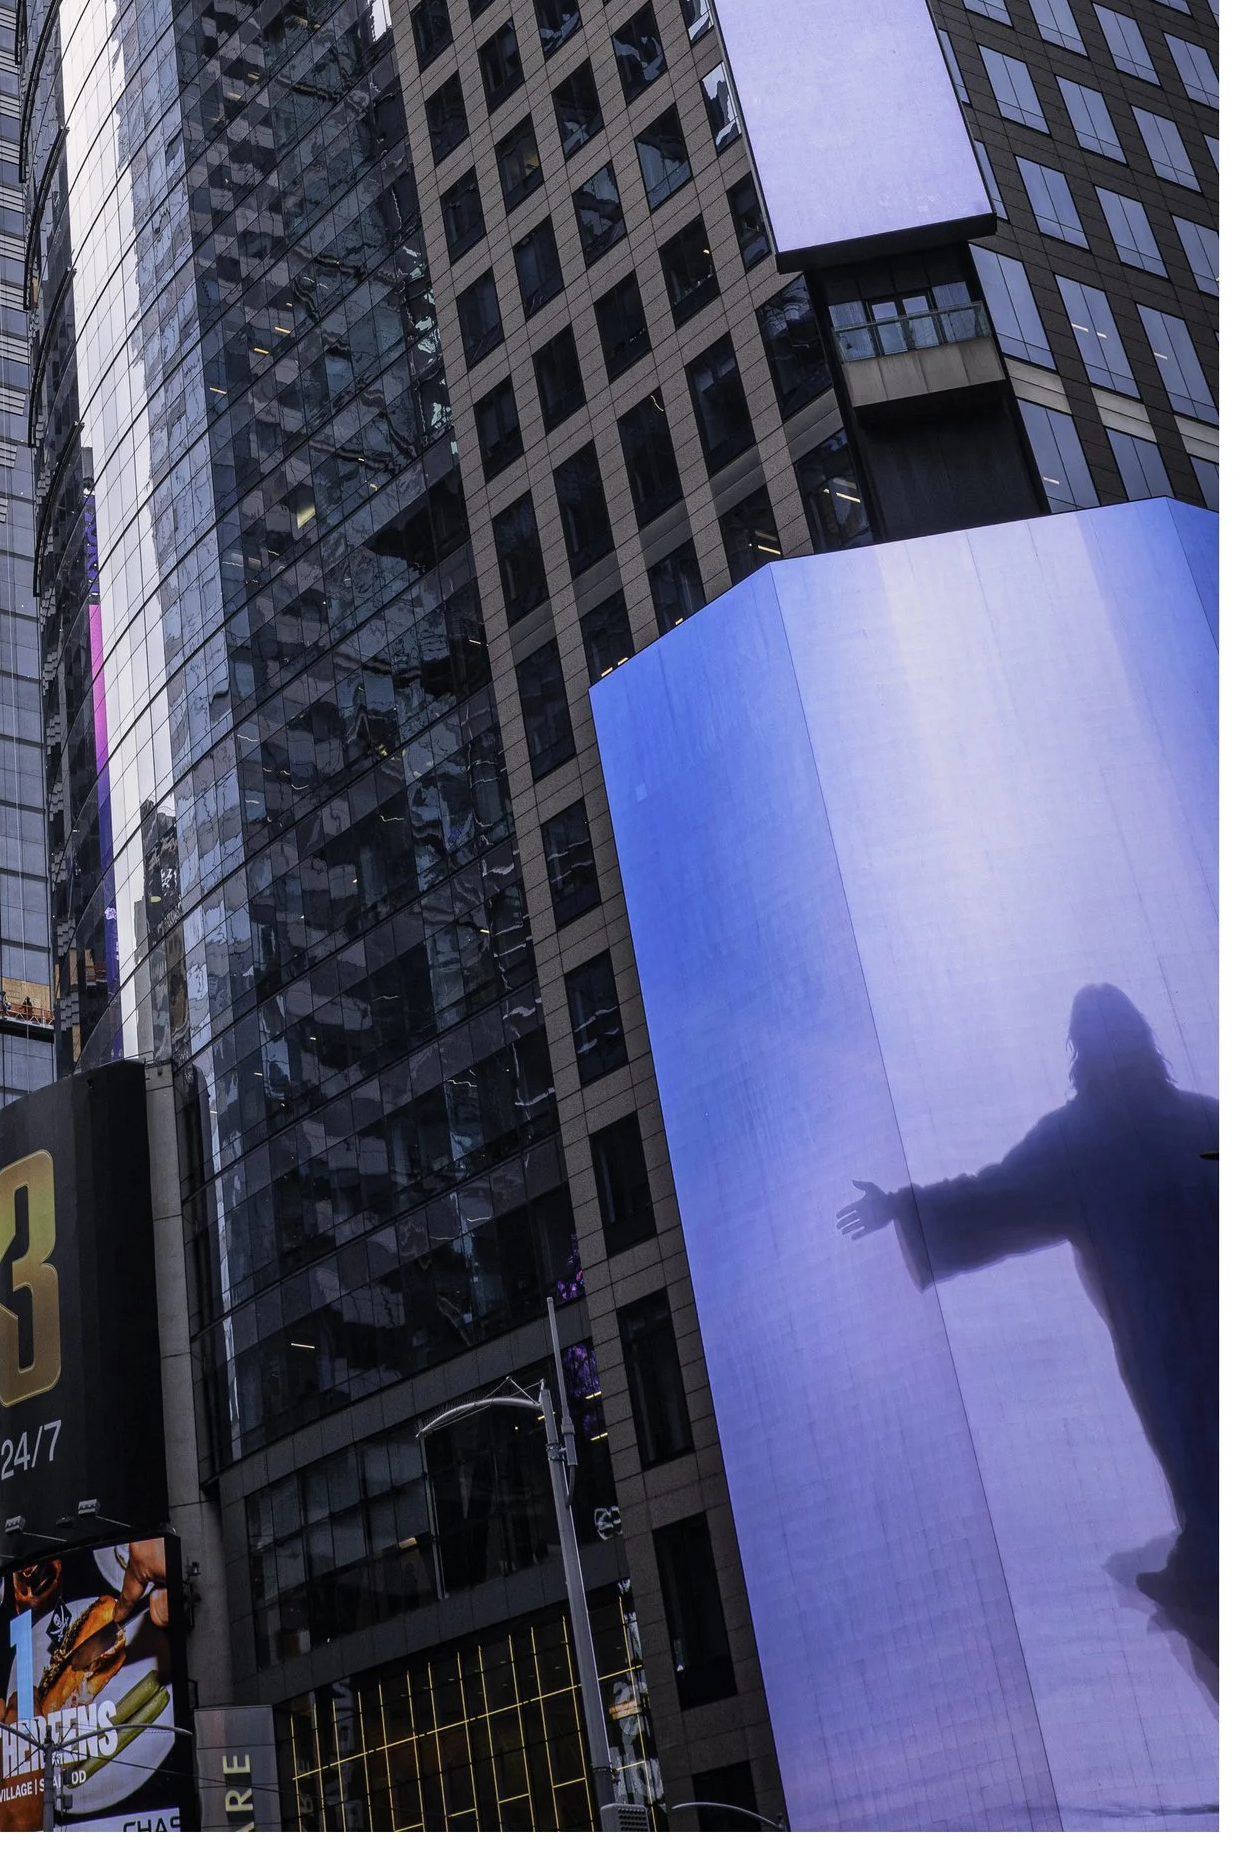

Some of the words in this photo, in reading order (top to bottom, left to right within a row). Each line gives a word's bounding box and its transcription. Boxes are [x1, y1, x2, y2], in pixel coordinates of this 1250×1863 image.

[0, 1419, 62, 1480] 24/7
[10, 1609, 34, 1732] 1
[222, 1754, 254, 1832] RE
